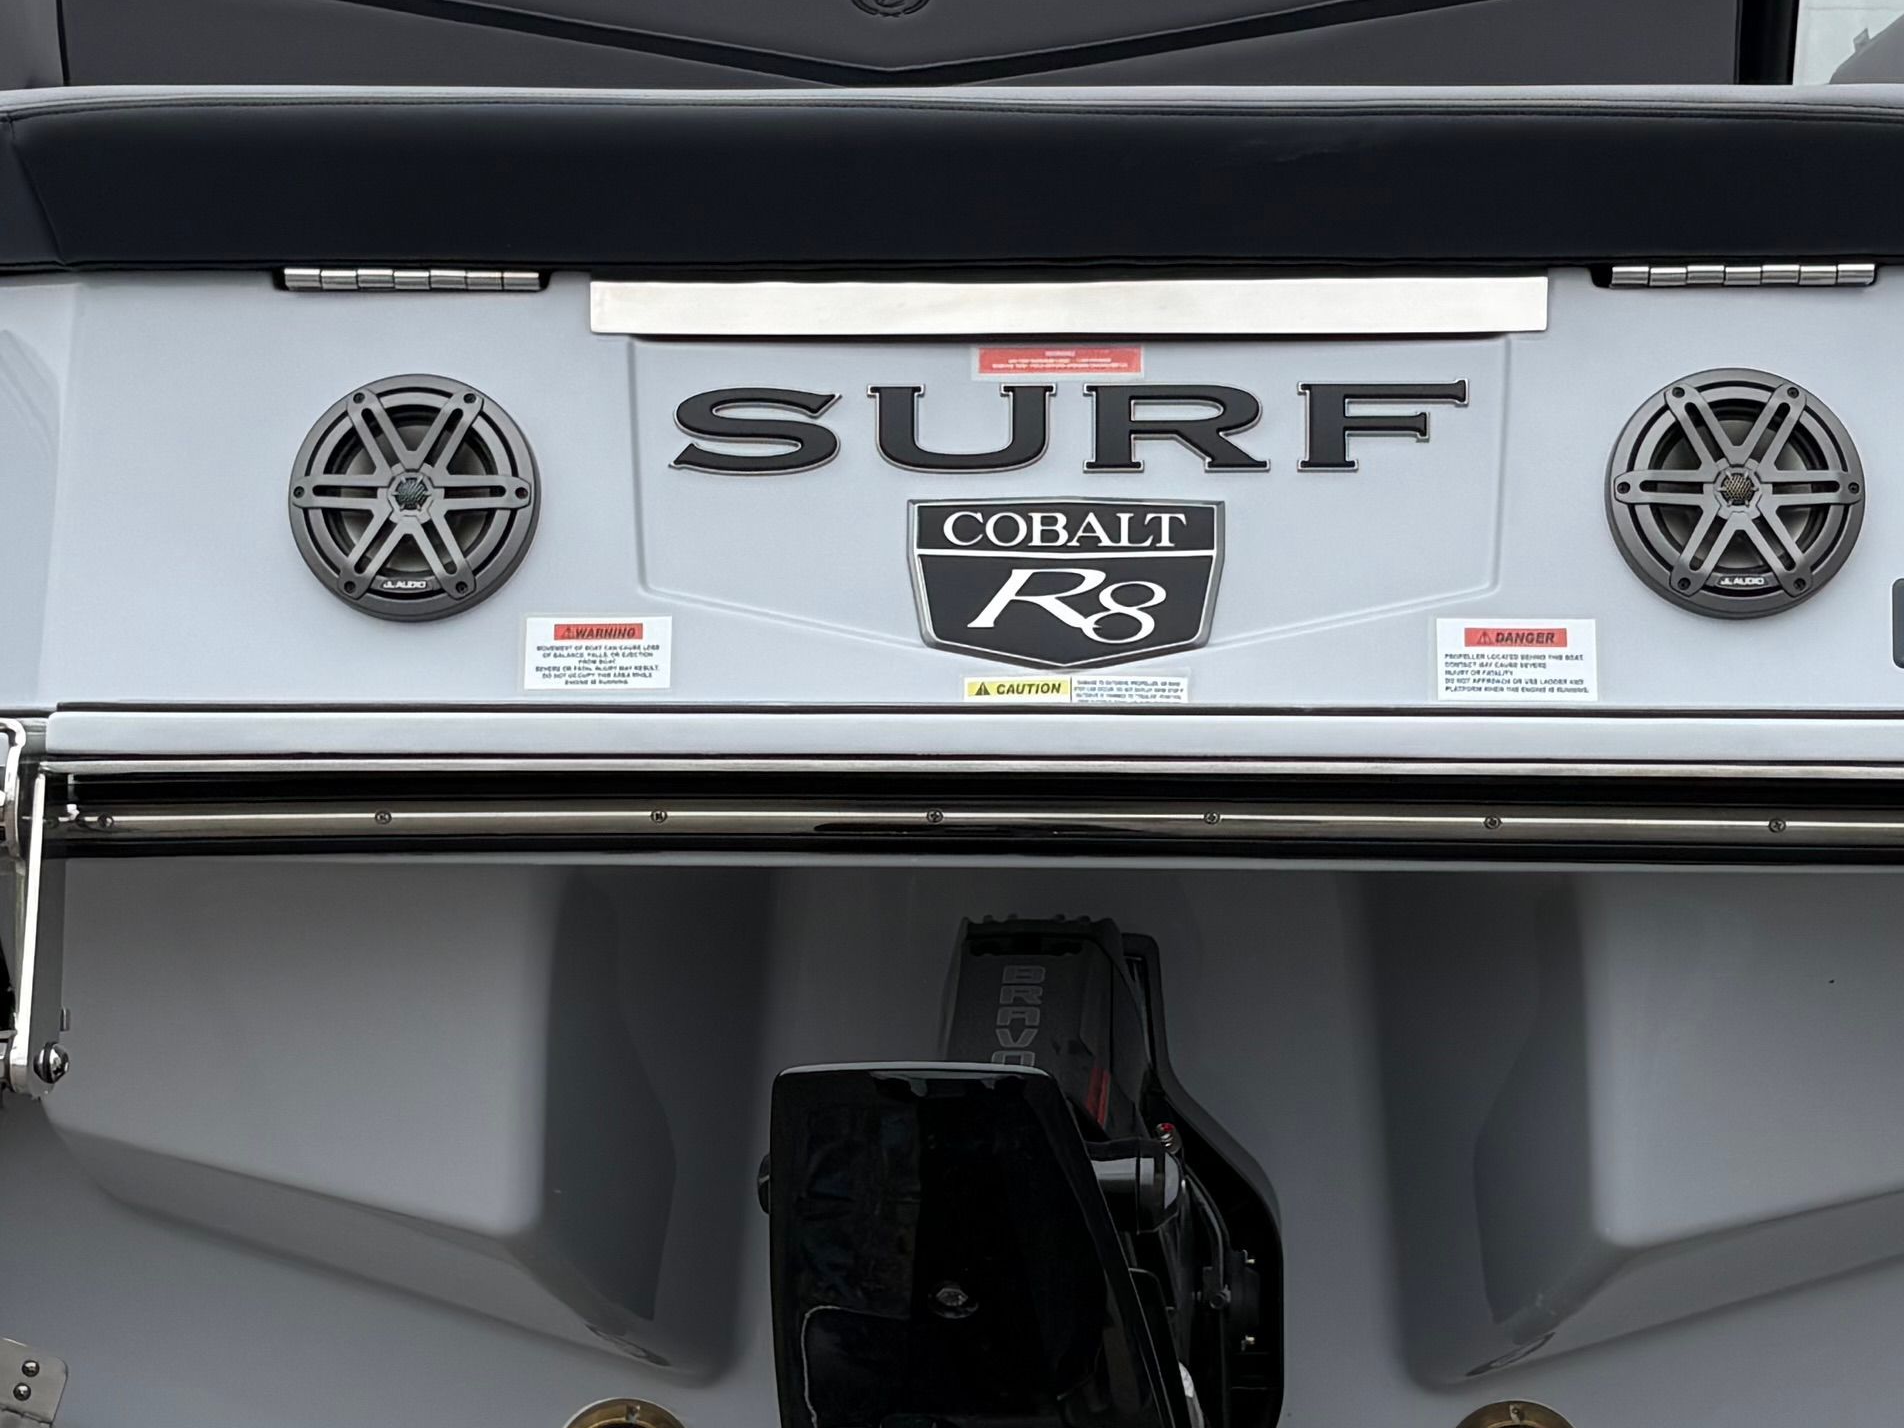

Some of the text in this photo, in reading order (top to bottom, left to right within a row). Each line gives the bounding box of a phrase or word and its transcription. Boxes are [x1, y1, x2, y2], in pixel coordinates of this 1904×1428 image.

[669, 378, 1470, 476] SURF
[943, 510, 1187, 548] COBALT
[966, 567, 1167, 645] R8
[575, 626, 636, 639] WARNING
[1495, 632, 1555, 644] DANGER
[996, 682, 1061, 696] CAUTION
